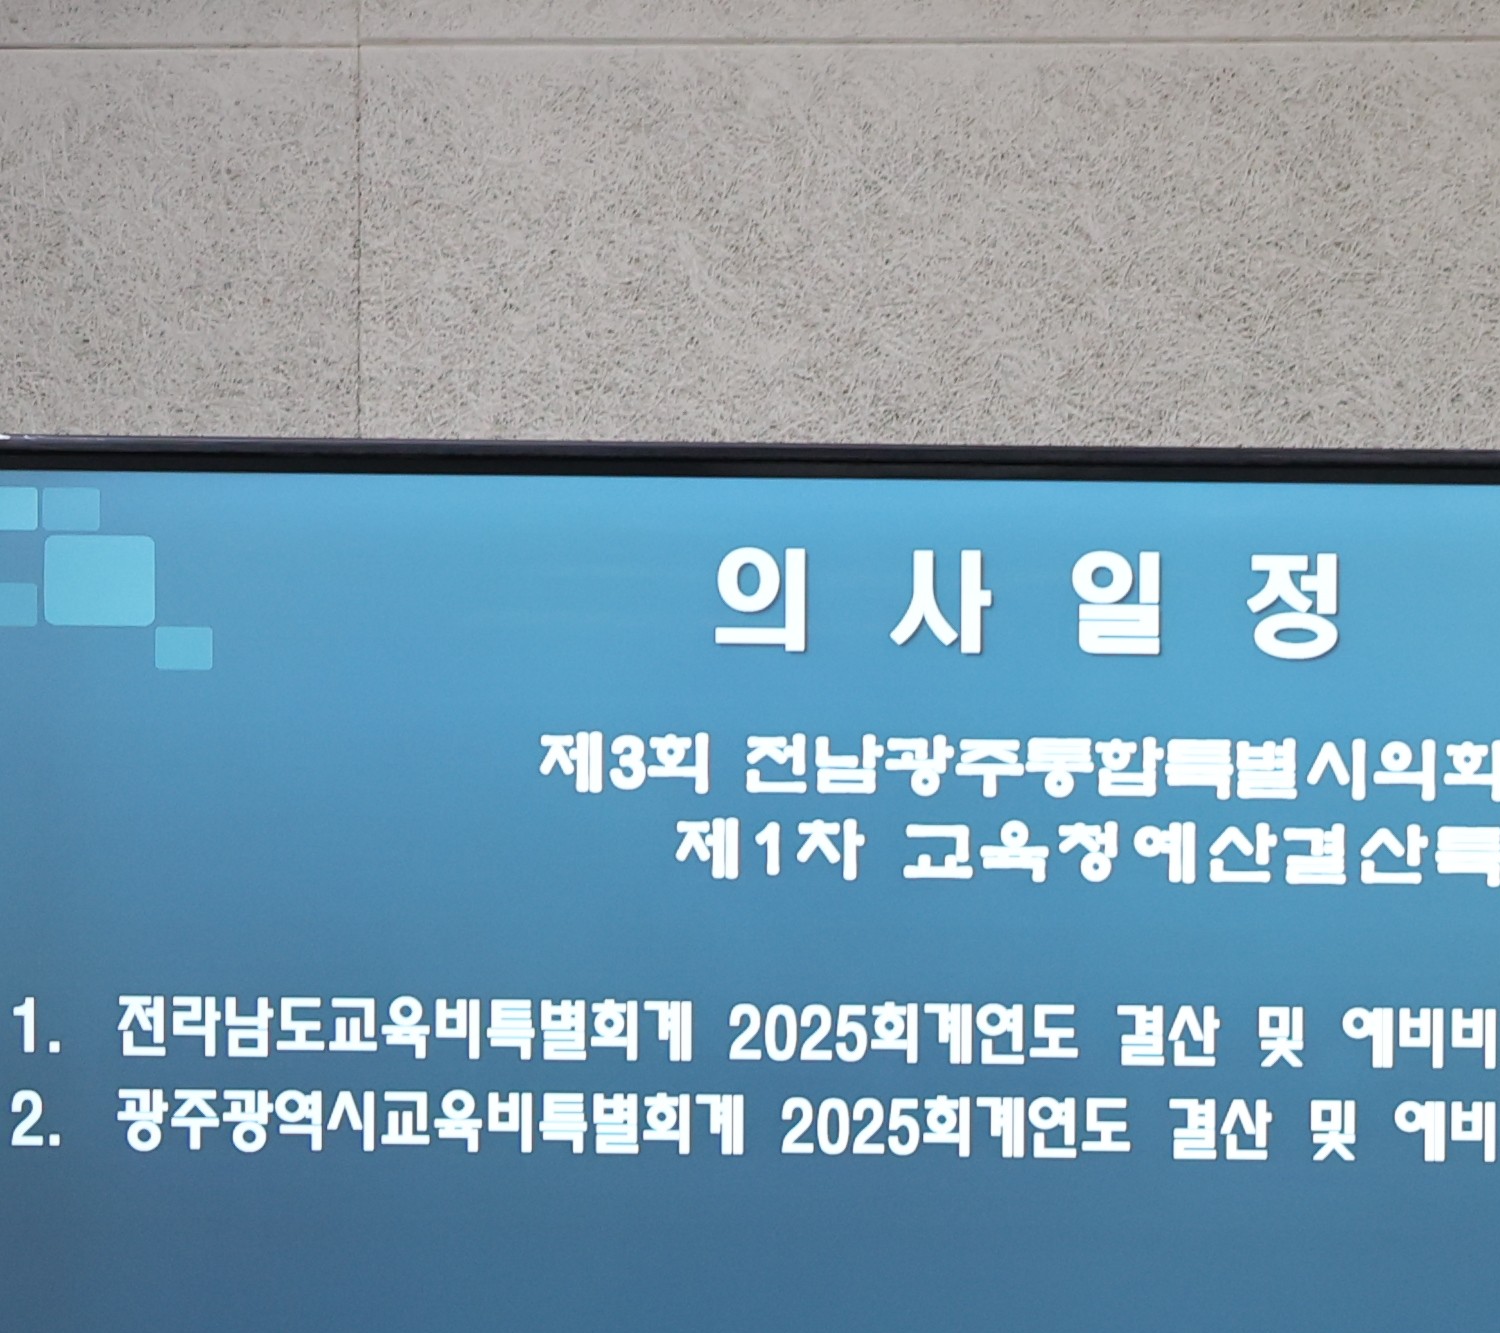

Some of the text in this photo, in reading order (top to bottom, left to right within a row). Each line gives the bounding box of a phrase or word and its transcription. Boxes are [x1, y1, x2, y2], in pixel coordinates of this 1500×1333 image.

[539, 730, 709, 795] 제3회
[675, 817, 865, 881] 제1차
[13, 997, 60, 1053] 1.
[117, 995, 692, 1062] 전라남도교육비특별회계
[729, 1001, 1079, 1065] 2025회계연도
[1116, 1004, 1221, 1067] 결산
[1258, 1006, 1304, 1068] 및
[1342, 1007, 1497, 1070] 예비비
[11, 1090, 60, 1146] 2.
[117, 1088, 744, 1155] 광주광역시교육비특별회계
[781, 1094, 1131, 1159] 2025회계연도
[1169, 1098, 1273, 1161] 결산
[1310, 1099, 1356, 1161] 및
